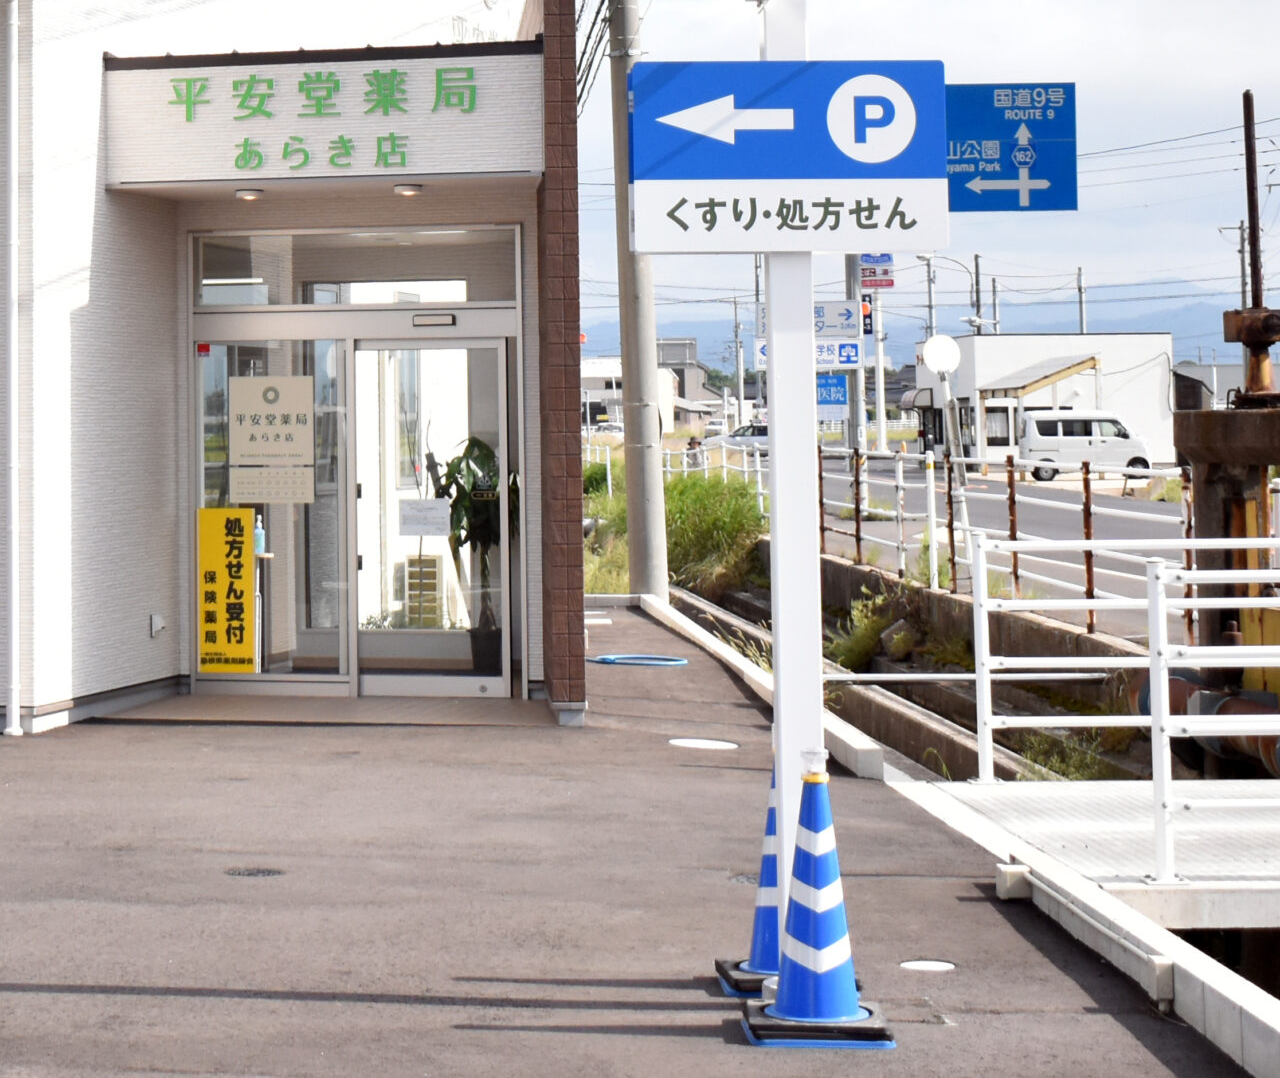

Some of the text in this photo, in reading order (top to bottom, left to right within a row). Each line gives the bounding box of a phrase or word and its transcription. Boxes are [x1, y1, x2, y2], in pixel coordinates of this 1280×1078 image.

[167, 67, 477, 123] 平安堂薬局
[994, 88, 1066, 107] 国道9号
[854, 95, 896, 144] P
[1004, 109, 1055, 120] ROUTE 9
[234, 132, 409, 170] あらき店
[1015, 151, 1032, 162] 162
[947, 161, 1001, 173] yama Park
[666, 196, 917, 232] くすり・処方せん
[235, 413, 308, 426] 平安堂薬局
[249, 433, 294, 442] あらき店
[224, 517, 245, 644] 処方せん受付
[203, 570, 217, 644] 保険薬局
